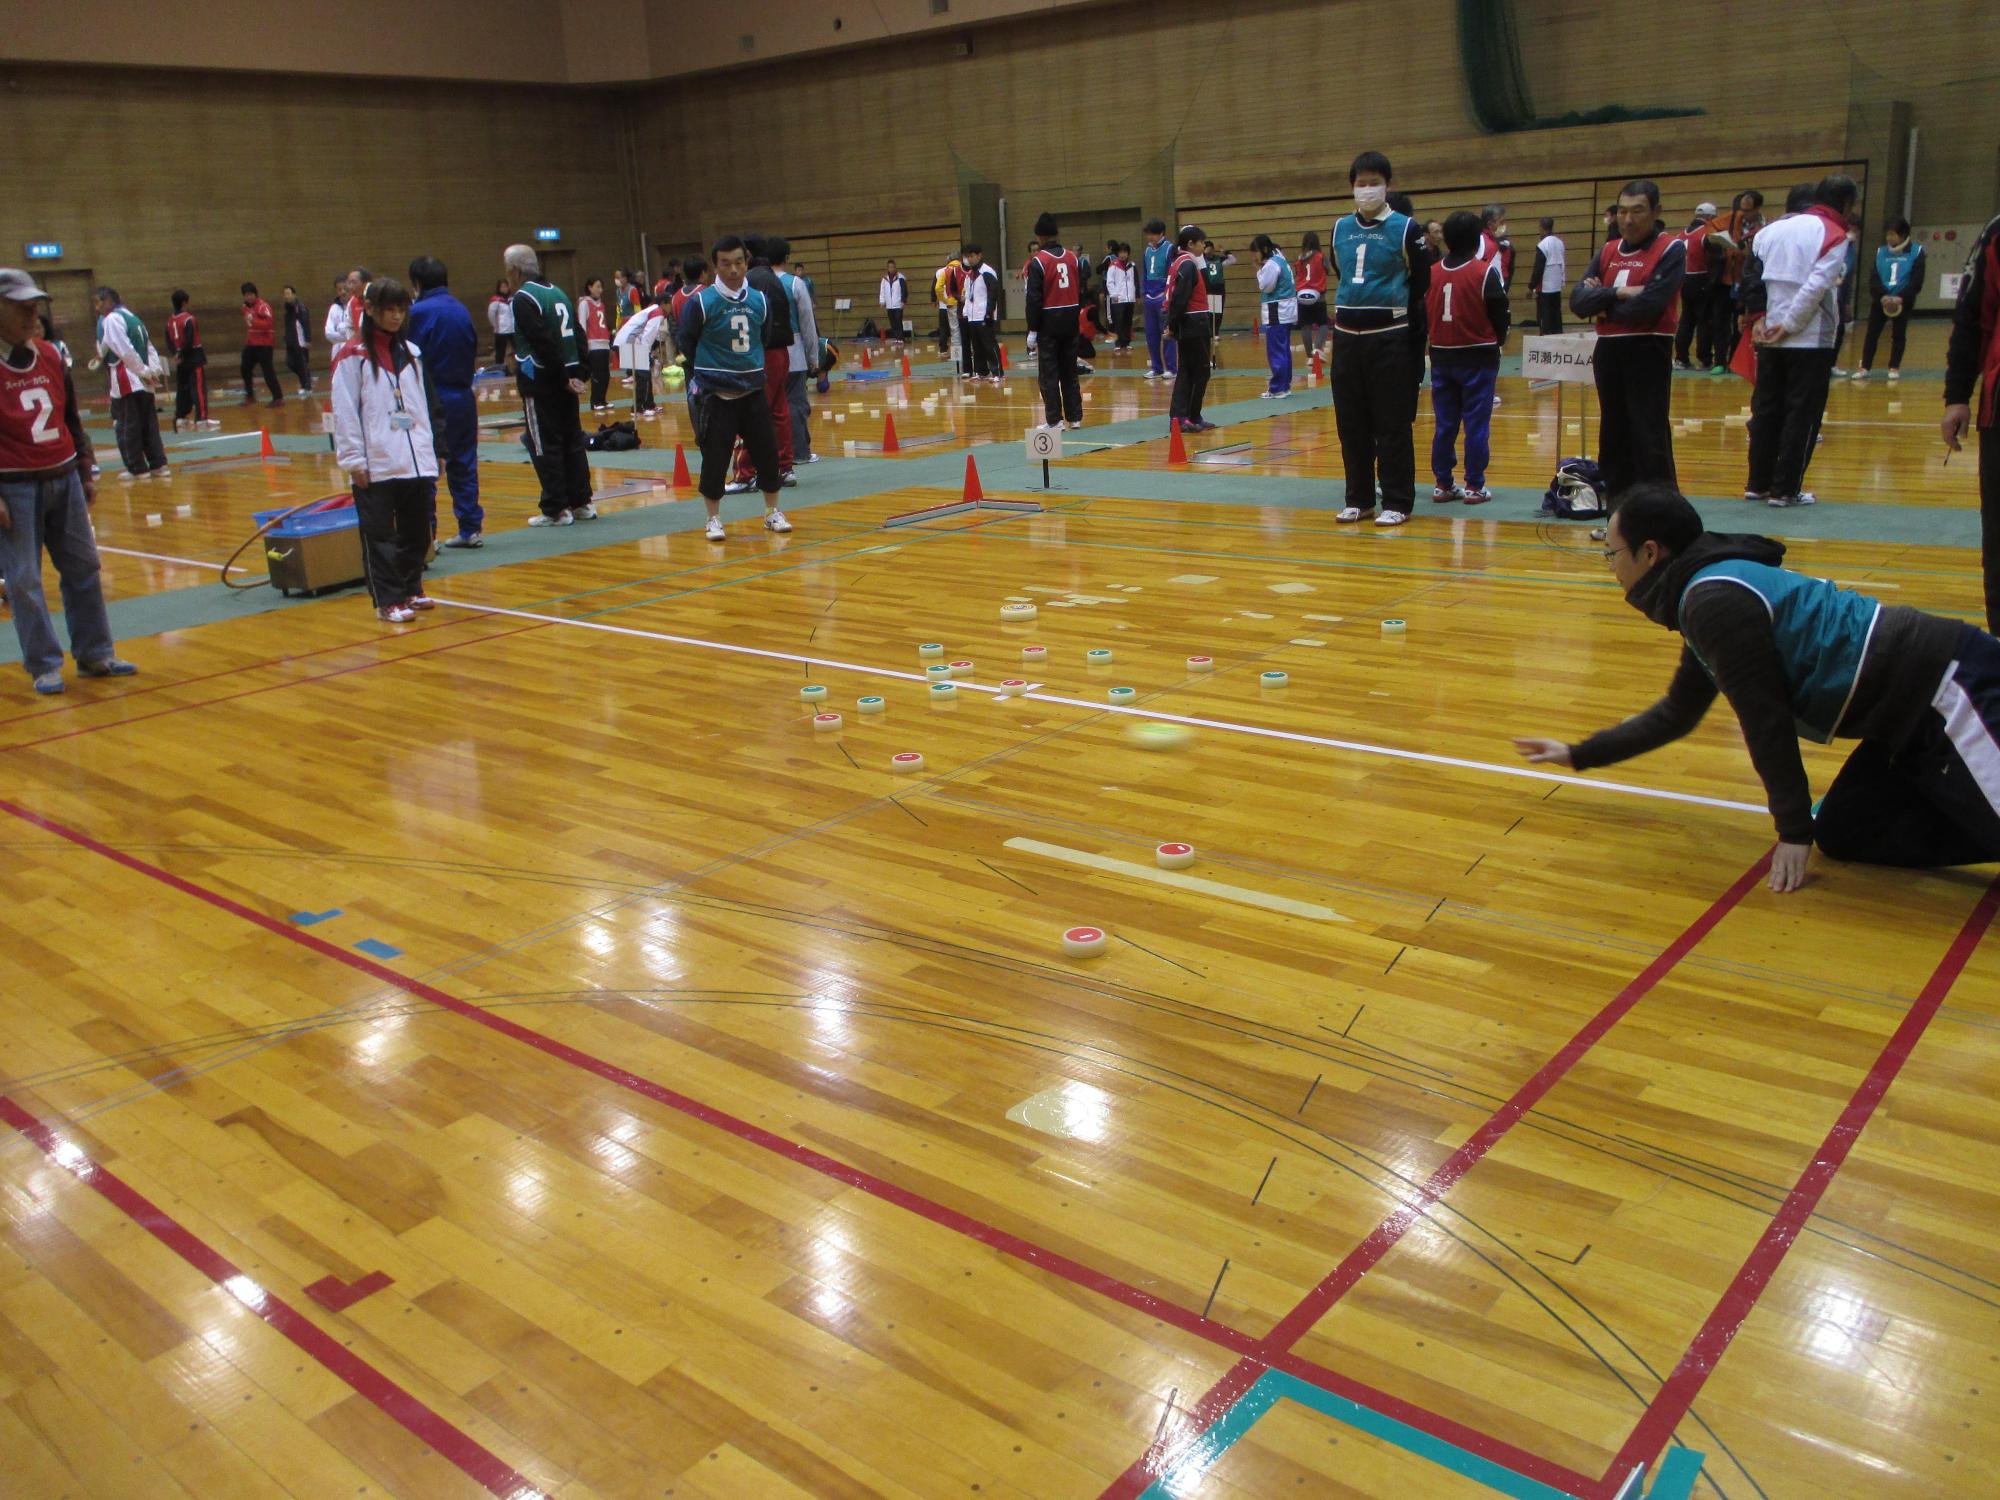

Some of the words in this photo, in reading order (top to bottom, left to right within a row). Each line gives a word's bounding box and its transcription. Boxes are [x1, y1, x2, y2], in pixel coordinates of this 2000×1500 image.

[1150, 256, 1155, 274] 1
[1209, 263, 1217, 276] 3
[1305, 263, 1311, 281] 1
[1352, 243, 1366, 284] 1
[1888, 262, 1898, 286] 1
[1056, 263, 1069, 289] 3
[1442, 282, 1453, 322] 1
[173, 321, 179, 339] 1
[555, 302, 574, 338] 2
[597, 310, 606, 329] 2
[731, 314, 750, 353] 3
[1528, 350, 1593, 366] 河瀬カロムA
[20, 387, 60, 444] 2
